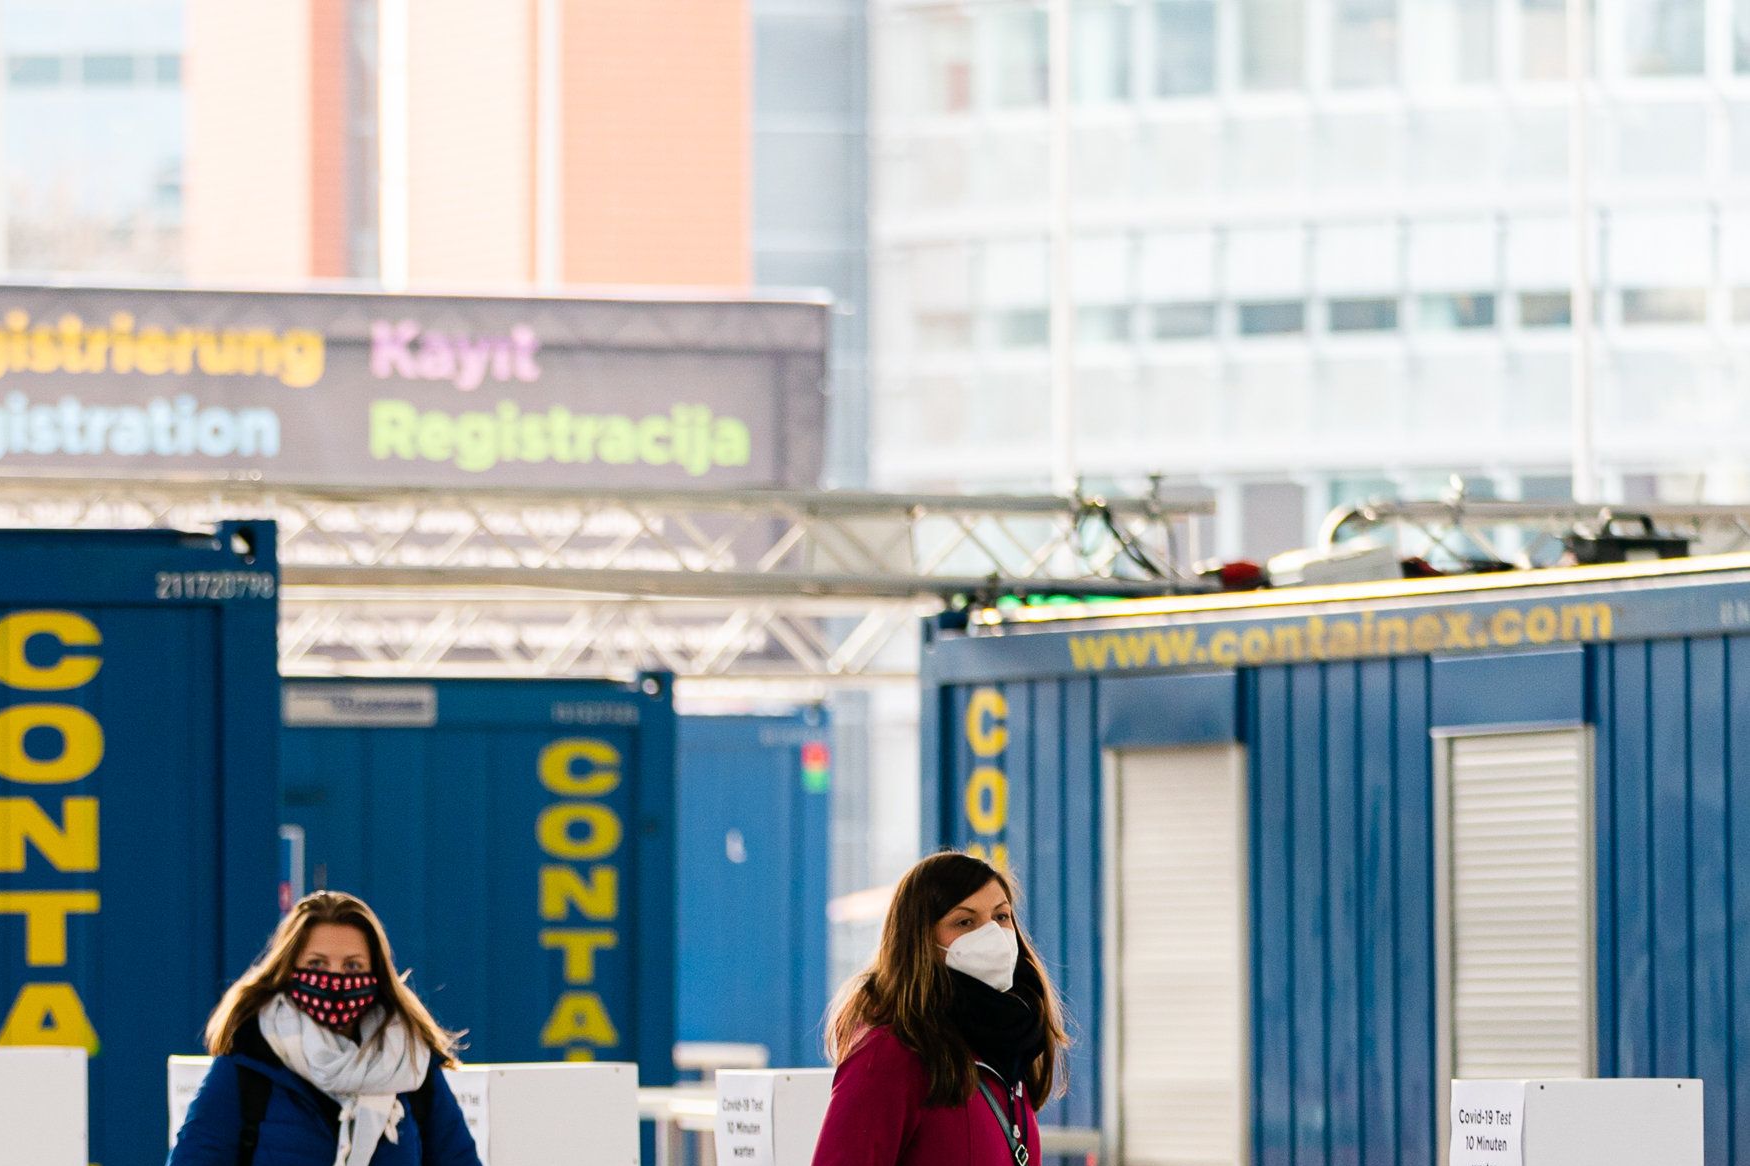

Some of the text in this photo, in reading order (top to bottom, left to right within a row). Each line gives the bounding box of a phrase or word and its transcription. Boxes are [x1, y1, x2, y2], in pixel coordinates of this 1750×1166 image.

[368, 399, 750, 477] Registracija
[1069, 601, 1613, 671] www.containex.com
[536, 737, 623, 1062] CONTA
[1459, 1109, 1512, 1125] Covid-19 Test
[1465, 1135, 1507, 1151] 10 Minuten
